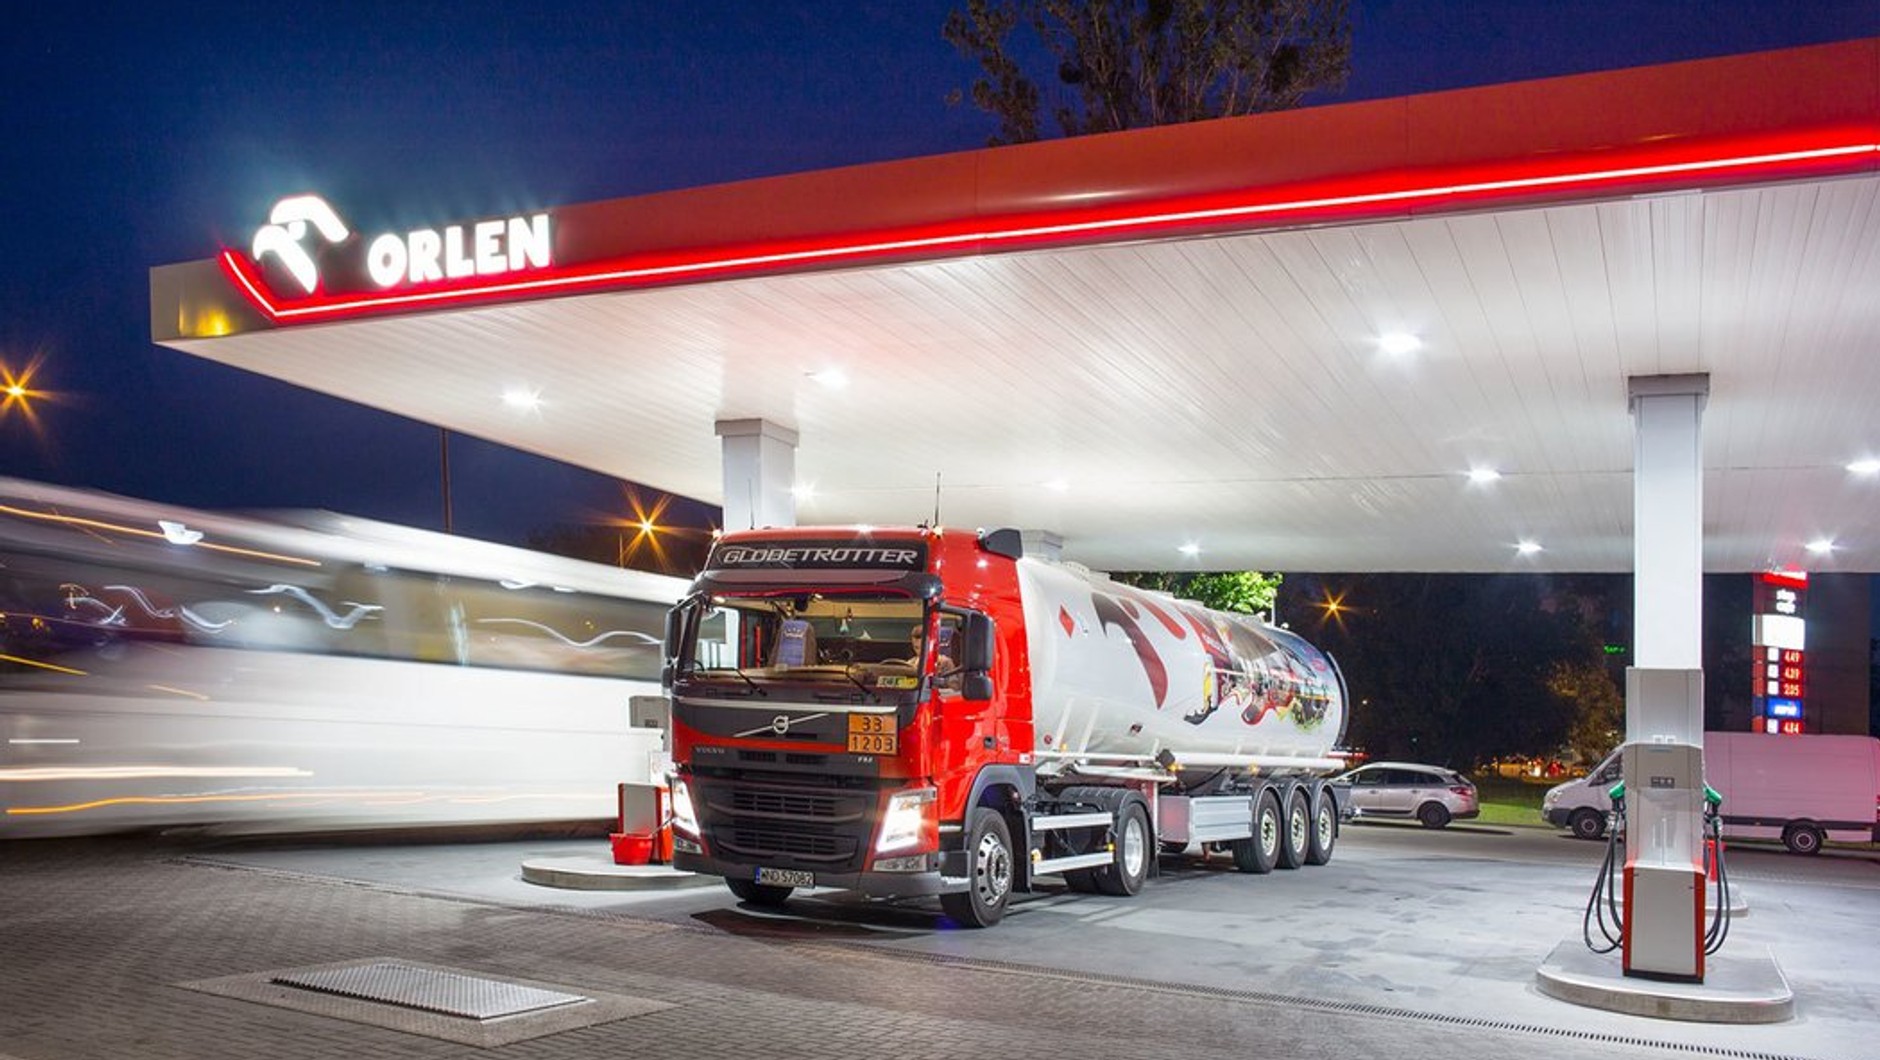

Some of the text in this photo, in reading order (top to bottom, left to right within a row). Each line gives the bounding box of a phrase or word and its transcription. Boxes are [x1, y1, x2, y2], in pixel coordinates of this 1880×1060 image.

[367, 213, 551, 288] ORLEN
[723, 549, 918, 564] GLOBETROTTER
[863, 716, 882, 732] 33
[852, 736, 893, 751] 1203
